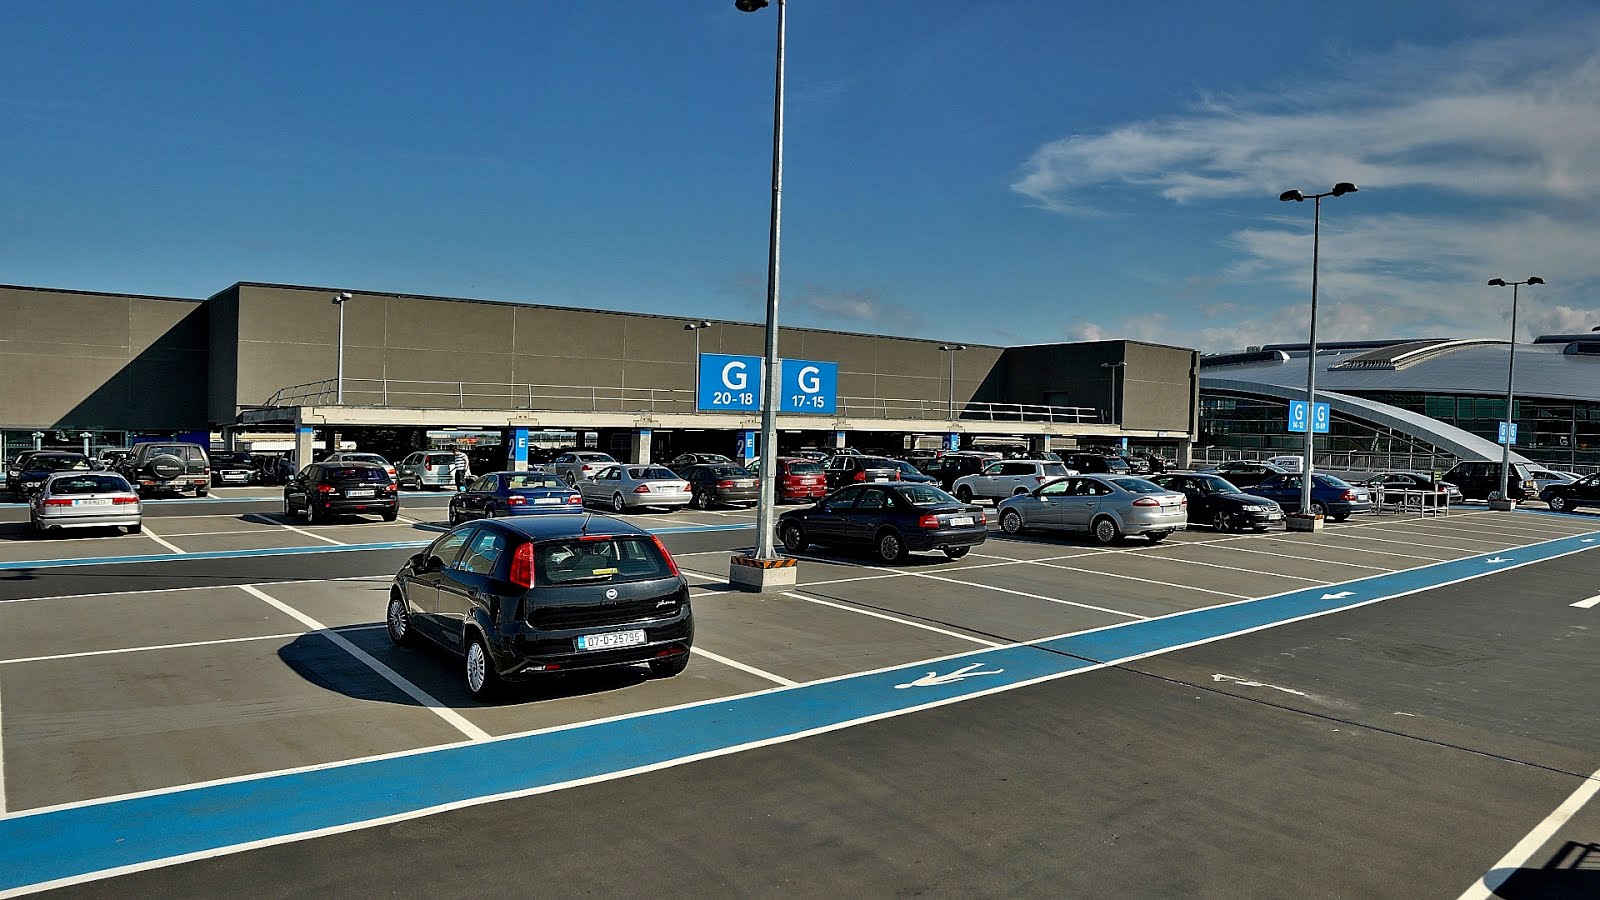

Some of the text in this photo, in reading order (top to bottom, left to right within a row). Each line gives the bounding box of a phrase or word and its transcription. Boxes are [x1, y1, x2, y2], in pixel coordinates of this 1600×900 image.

[722, 361, 747, 390] G
[797, 366, 820, 394] G
[713, 392, 753, 405] 20-18
[792, 395, 825, 408] 17-15
[1294, 404, 1303, 420] G
[1317, 406, 1325, 422] G
[508, 438, 514, 459] 2
[518, 438, 526, 448] E
[737, 439, 744, 457] 2
[747, 438, 753, 448] E
[588, 632, 640, 647] 07-D-25795
